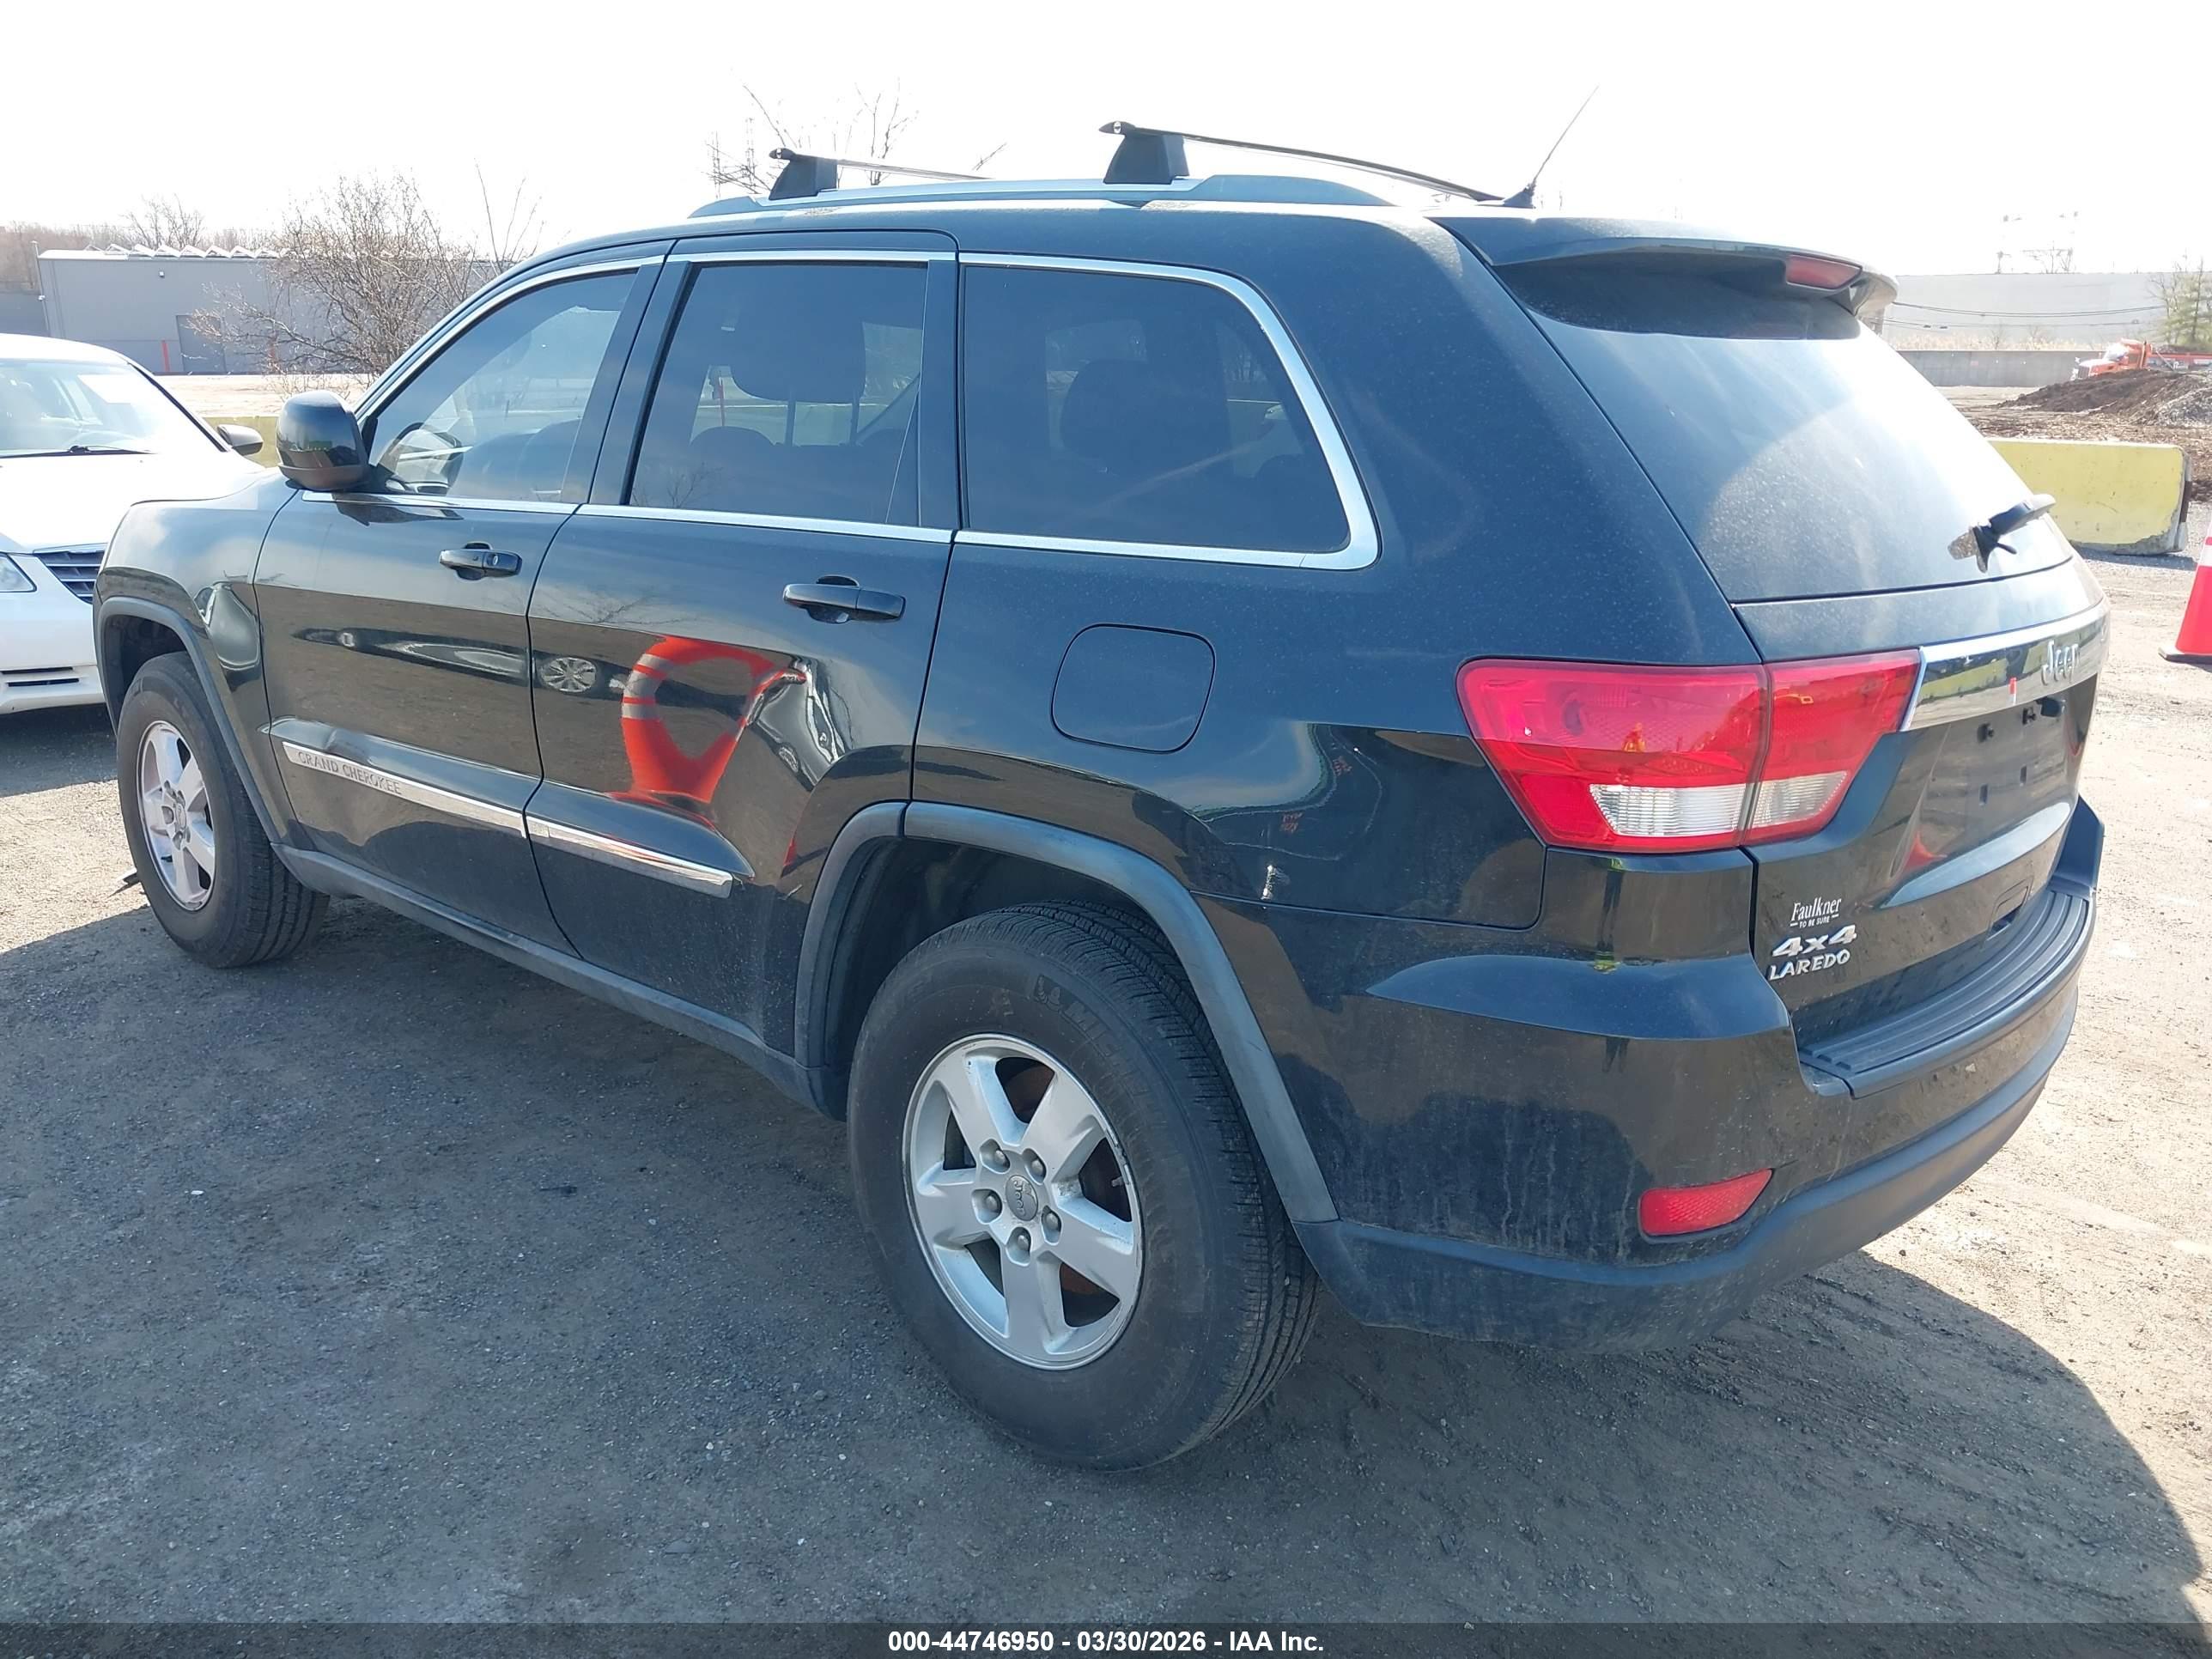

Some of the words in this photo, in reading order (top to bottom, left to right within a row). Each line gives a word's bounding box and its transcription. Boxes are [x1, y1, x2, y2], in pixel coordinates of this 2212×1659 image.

[2041, 640, 2080, 685] Jeep
[298, 751, 339, 774] GRAND
[343, 764, 402, 795] CHEROKEE
[1790, 896, 1842, 921] Faulkner
[1800, 920, 1807, 928] TO
[1808, 918, 1815, 927] BE
[1816, 915, 1830, 925] SURE
[1771, 925, 1856, 957] 4x4
[1769, 949, 1850, 981] LAREDO
